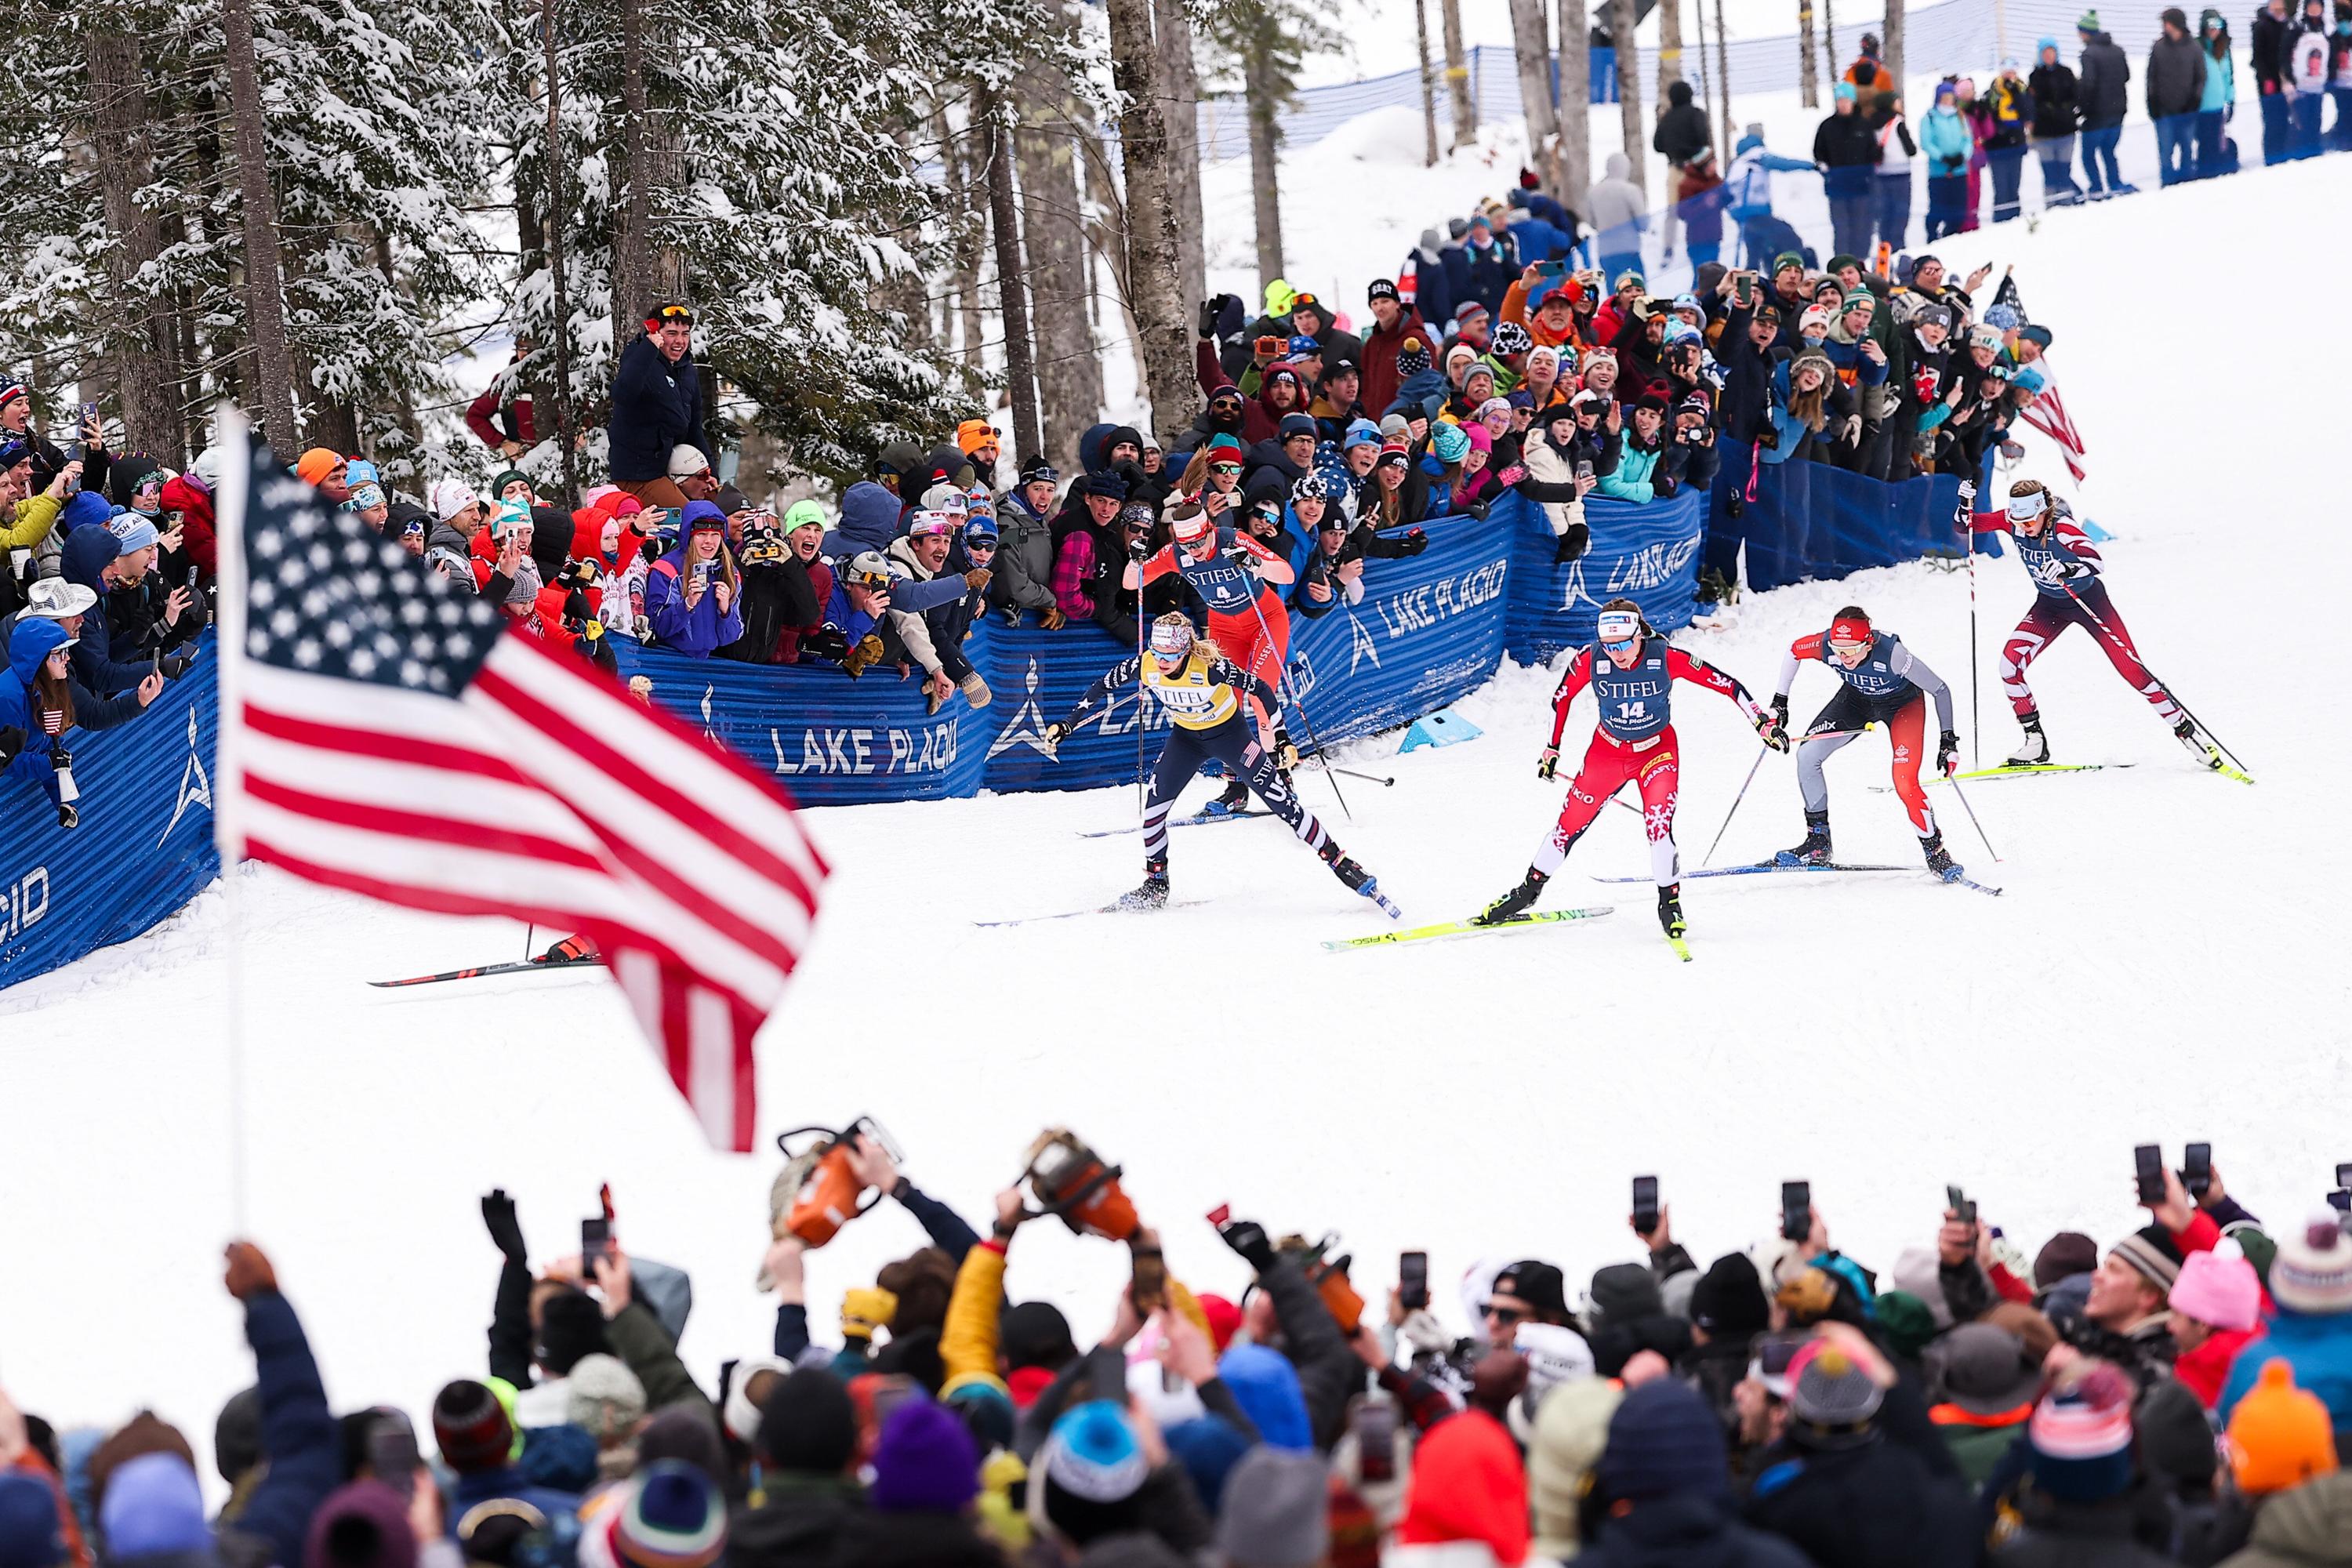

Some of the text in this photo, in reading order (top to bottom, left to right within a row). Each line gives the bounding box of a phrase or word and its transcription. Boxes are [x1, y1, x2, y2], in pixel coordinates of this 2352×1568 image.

[1235, 535, 1265, 556] helvetia
[1186, 567, 1243, 586] STIFEL
[1216, 586, 1231, 600] 4
[1225, 592, 1247, 604] Placid
[1376, 559, 1507, 639] LAKE PLACID
[1225, 660, 1239, 685] STIF
[1599, 680, 1663, 699] STIFEL
[1610, 713, 1654, 725] Lake Placid
[1617, 701, 1646, 719] 14
[1808, 720, 1837, 735] swix
[771, 715, 959, 775] LAKE PLACID
[1252, 755, 1274, 786] STIF
[1642, 764, 1671, 787] CRAFT
[1204, 813, 1233, 824] SALOMON
